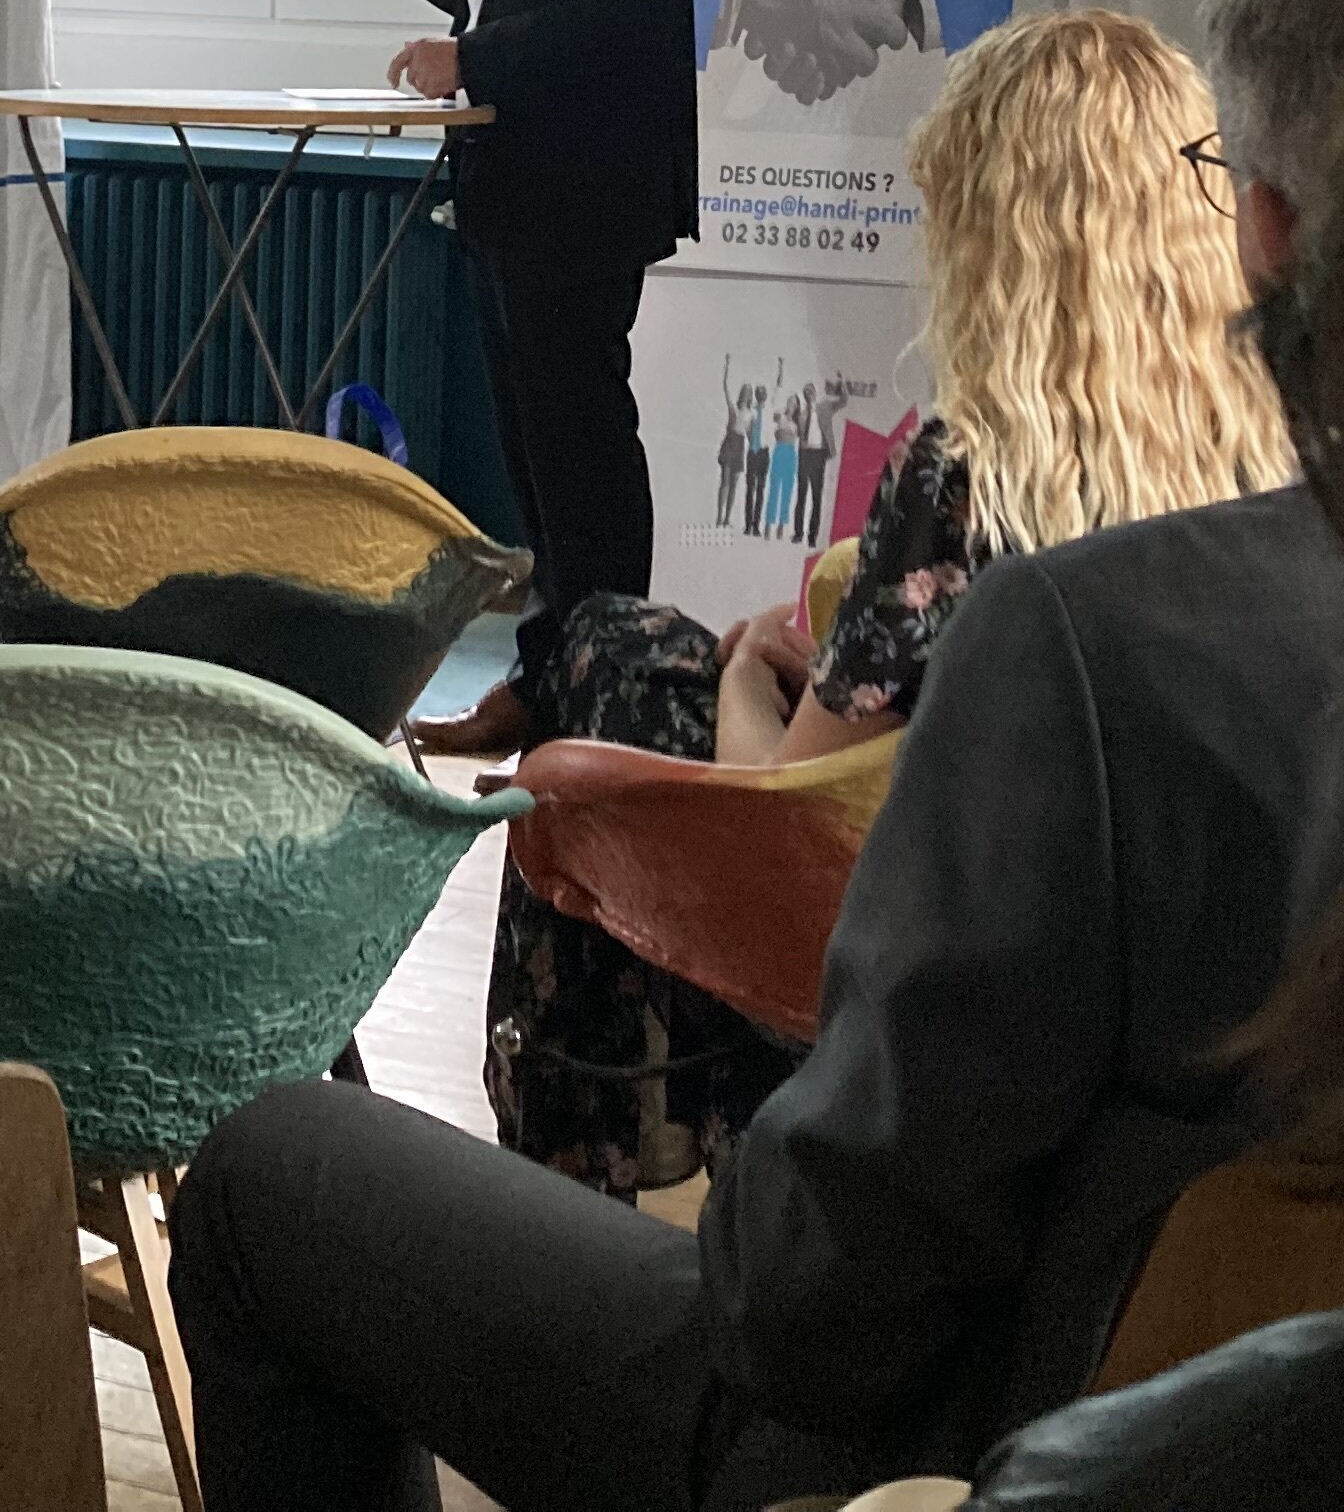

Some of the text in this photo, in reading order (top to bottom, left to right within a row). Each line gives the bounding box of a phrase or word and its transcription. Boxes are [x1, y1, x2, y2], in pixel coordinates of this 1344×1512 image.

[719, 165, 894, 192] DES QUESTIONS ?
[722, 223, 880, 253] 02 33 88 02 49
